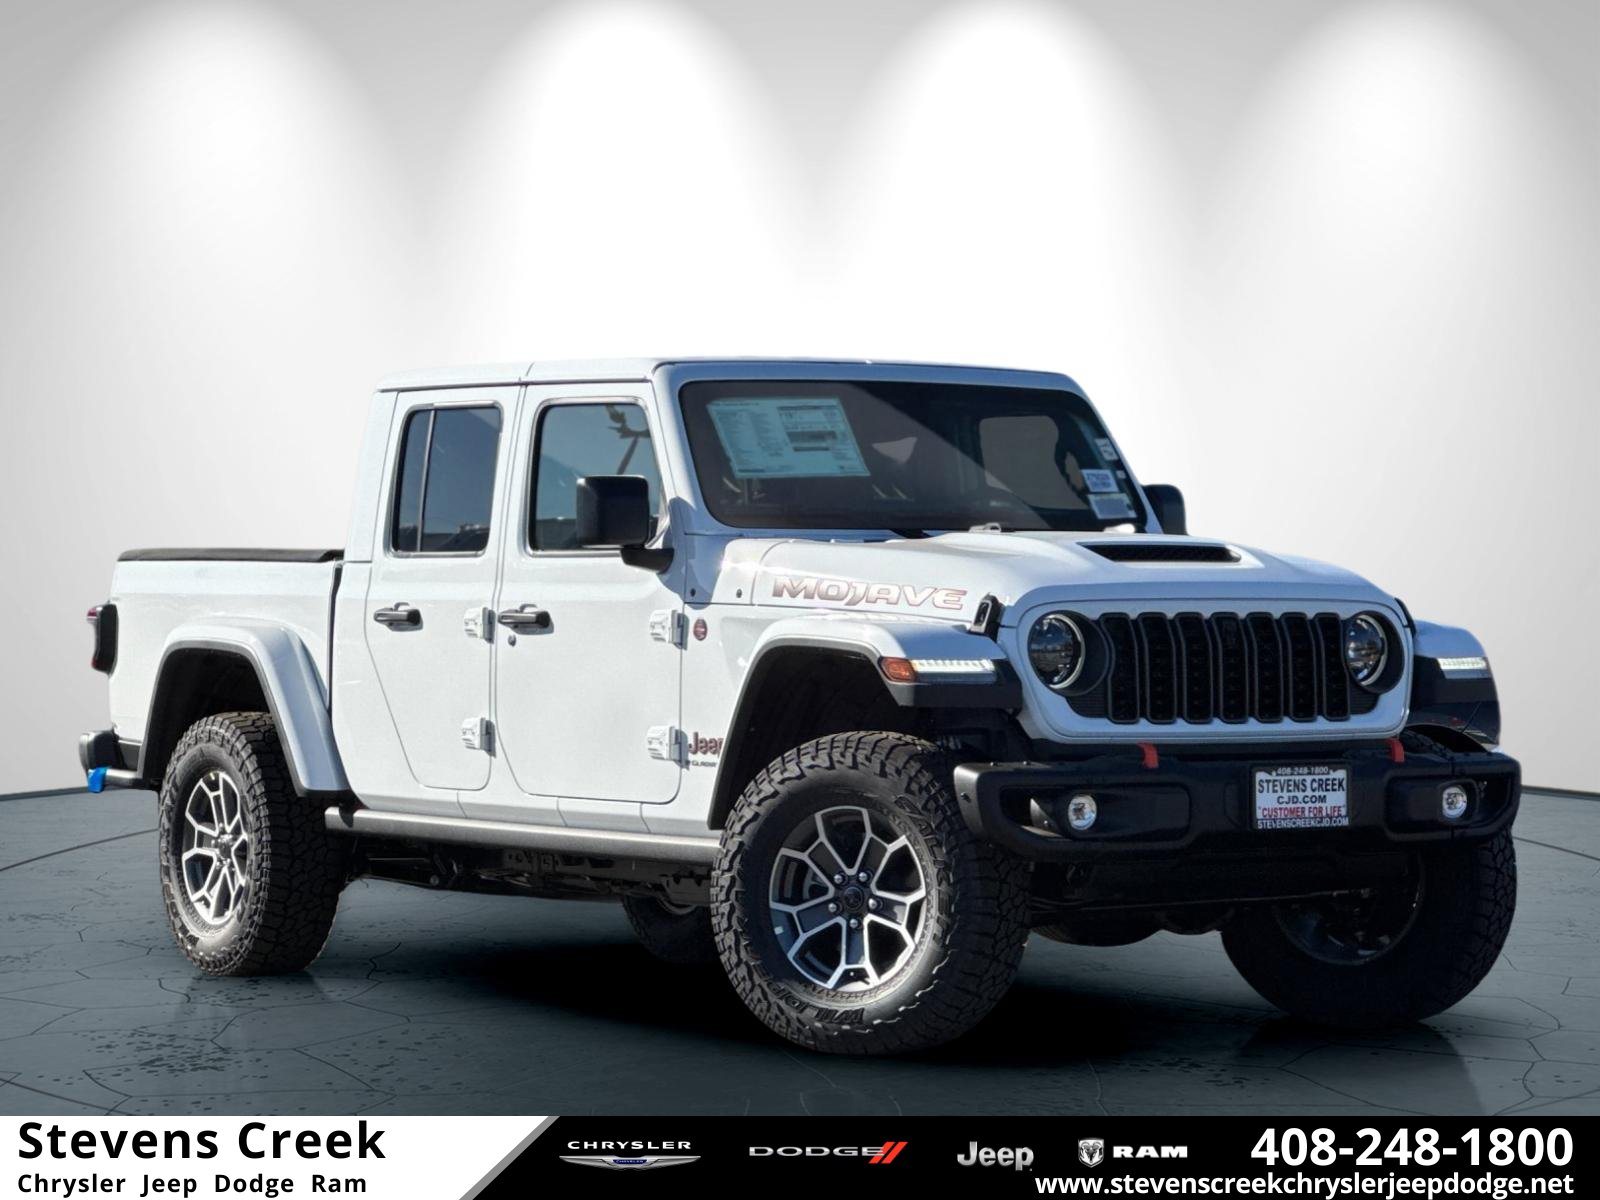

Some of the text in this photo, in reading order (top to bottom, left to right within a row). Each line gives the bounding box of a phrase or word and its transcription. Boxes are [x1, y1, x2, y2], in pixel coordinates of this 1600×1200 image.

[772, 576, 967, 610] MOJAVE
[1277, 767, 1329, 775] 408-248-1800
[1258, 778, 1345, 793] STEVENS CREEK
[1277, 795, 1327, 805] CJD.COM
[1308, 806, 1324, 817] FOR
